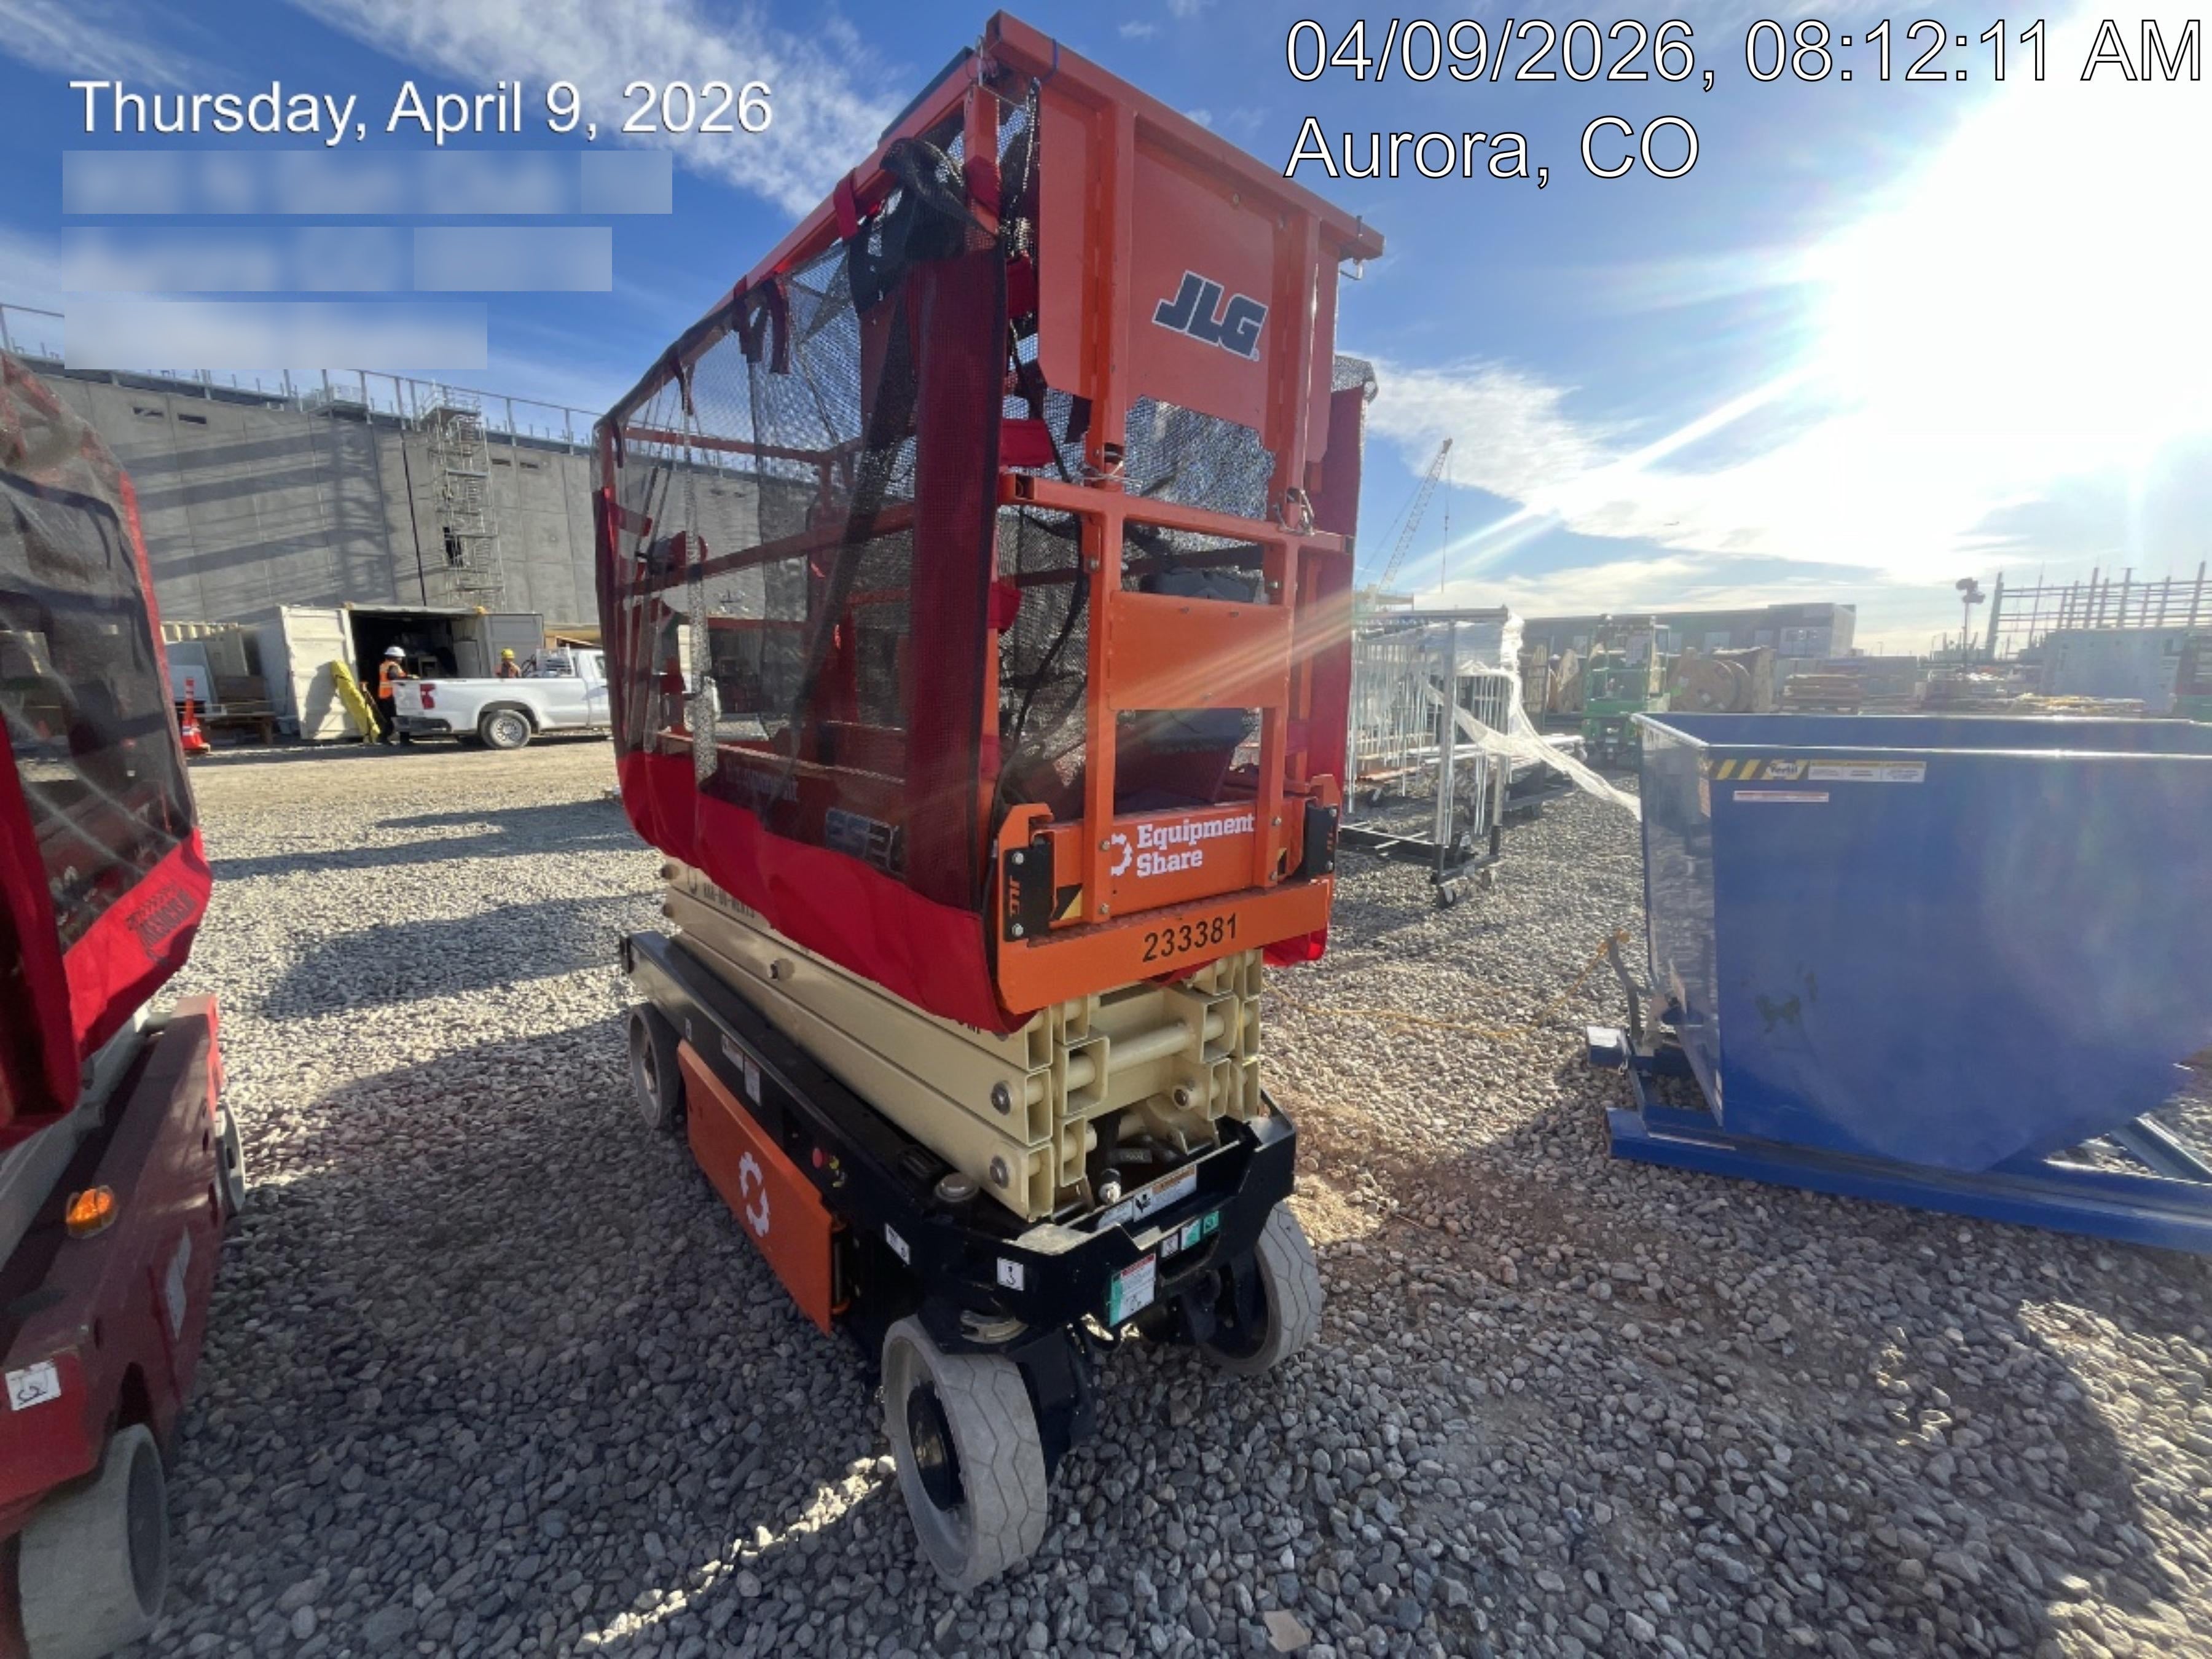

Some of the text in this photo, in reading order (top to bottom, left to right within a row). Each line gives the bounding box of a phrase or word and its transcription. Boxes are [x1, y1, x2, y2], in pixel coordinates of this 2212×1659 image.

[1151, 269, 1268, 361] JLG
[1137, 813, 1255, 850] Equipment
[1137, 849, 1203, 877] Share
[1142, 912, 1237, 962] 233381
